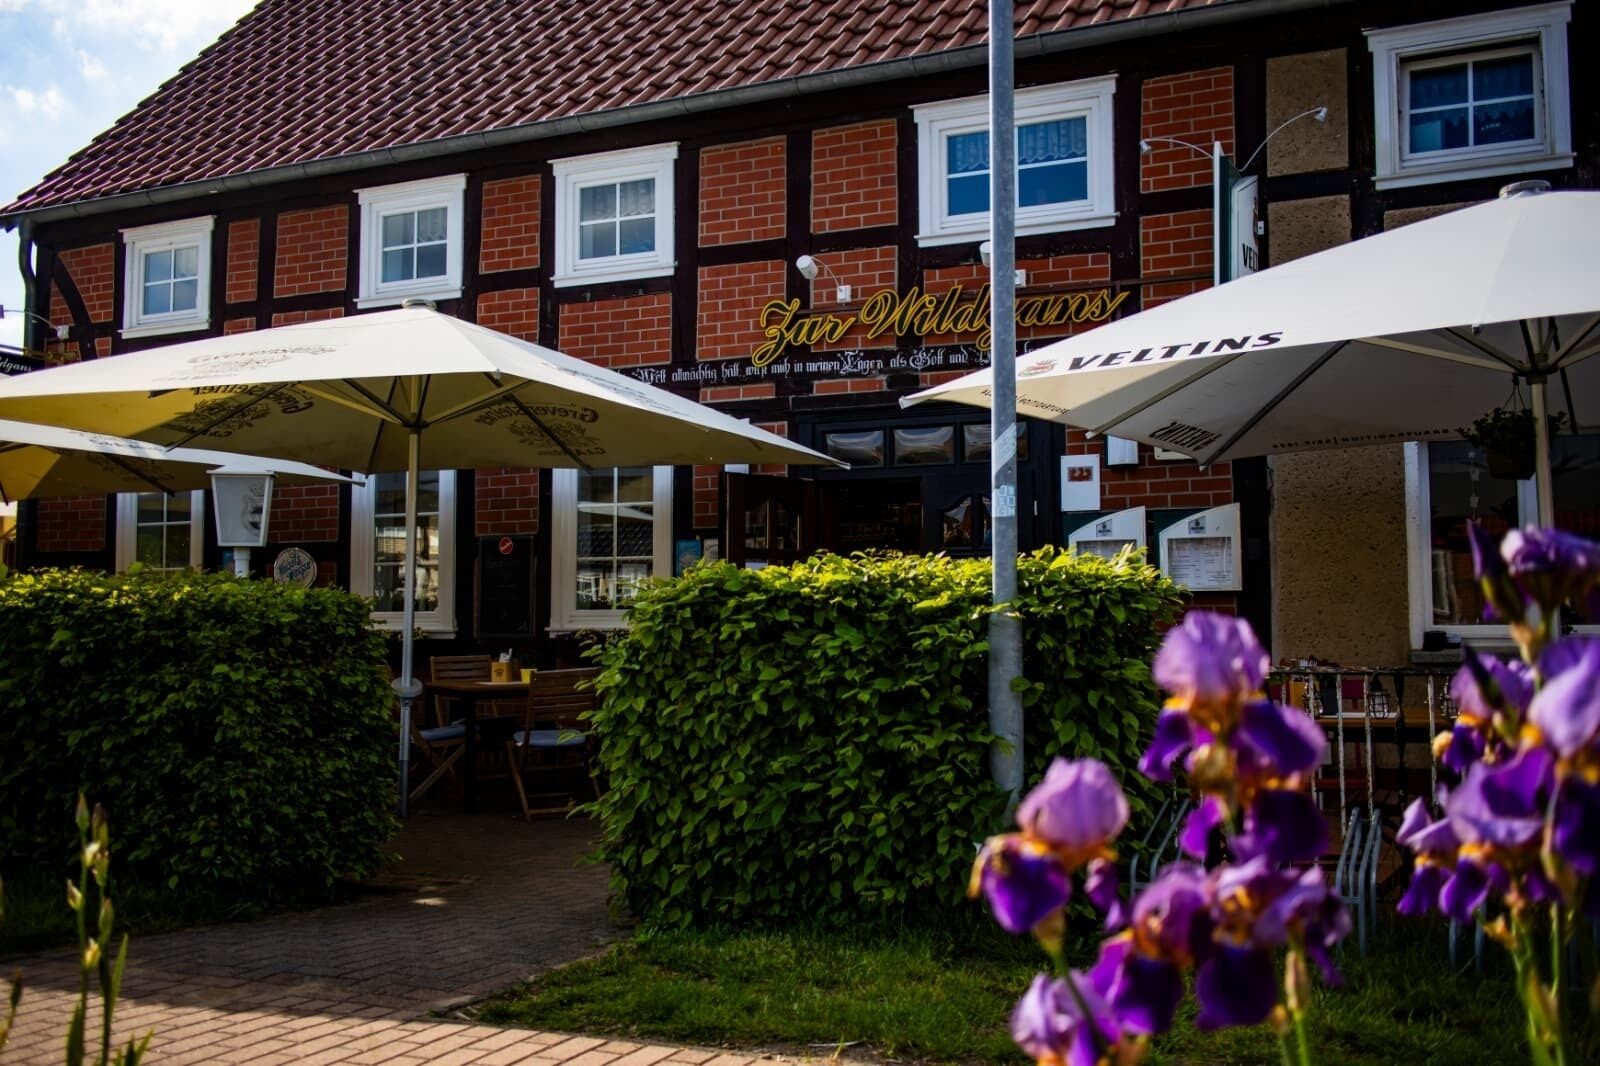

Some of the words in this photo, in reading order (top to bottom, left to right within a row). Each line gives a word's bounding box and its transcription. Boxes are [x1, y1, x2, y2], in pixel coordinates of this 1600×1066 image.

[752, 298, 855, 367] Zur
[1067, 331, 1283, 371] VELTINS
[794, 360, 802, 373] in
[890, 351, 907, 369] als
